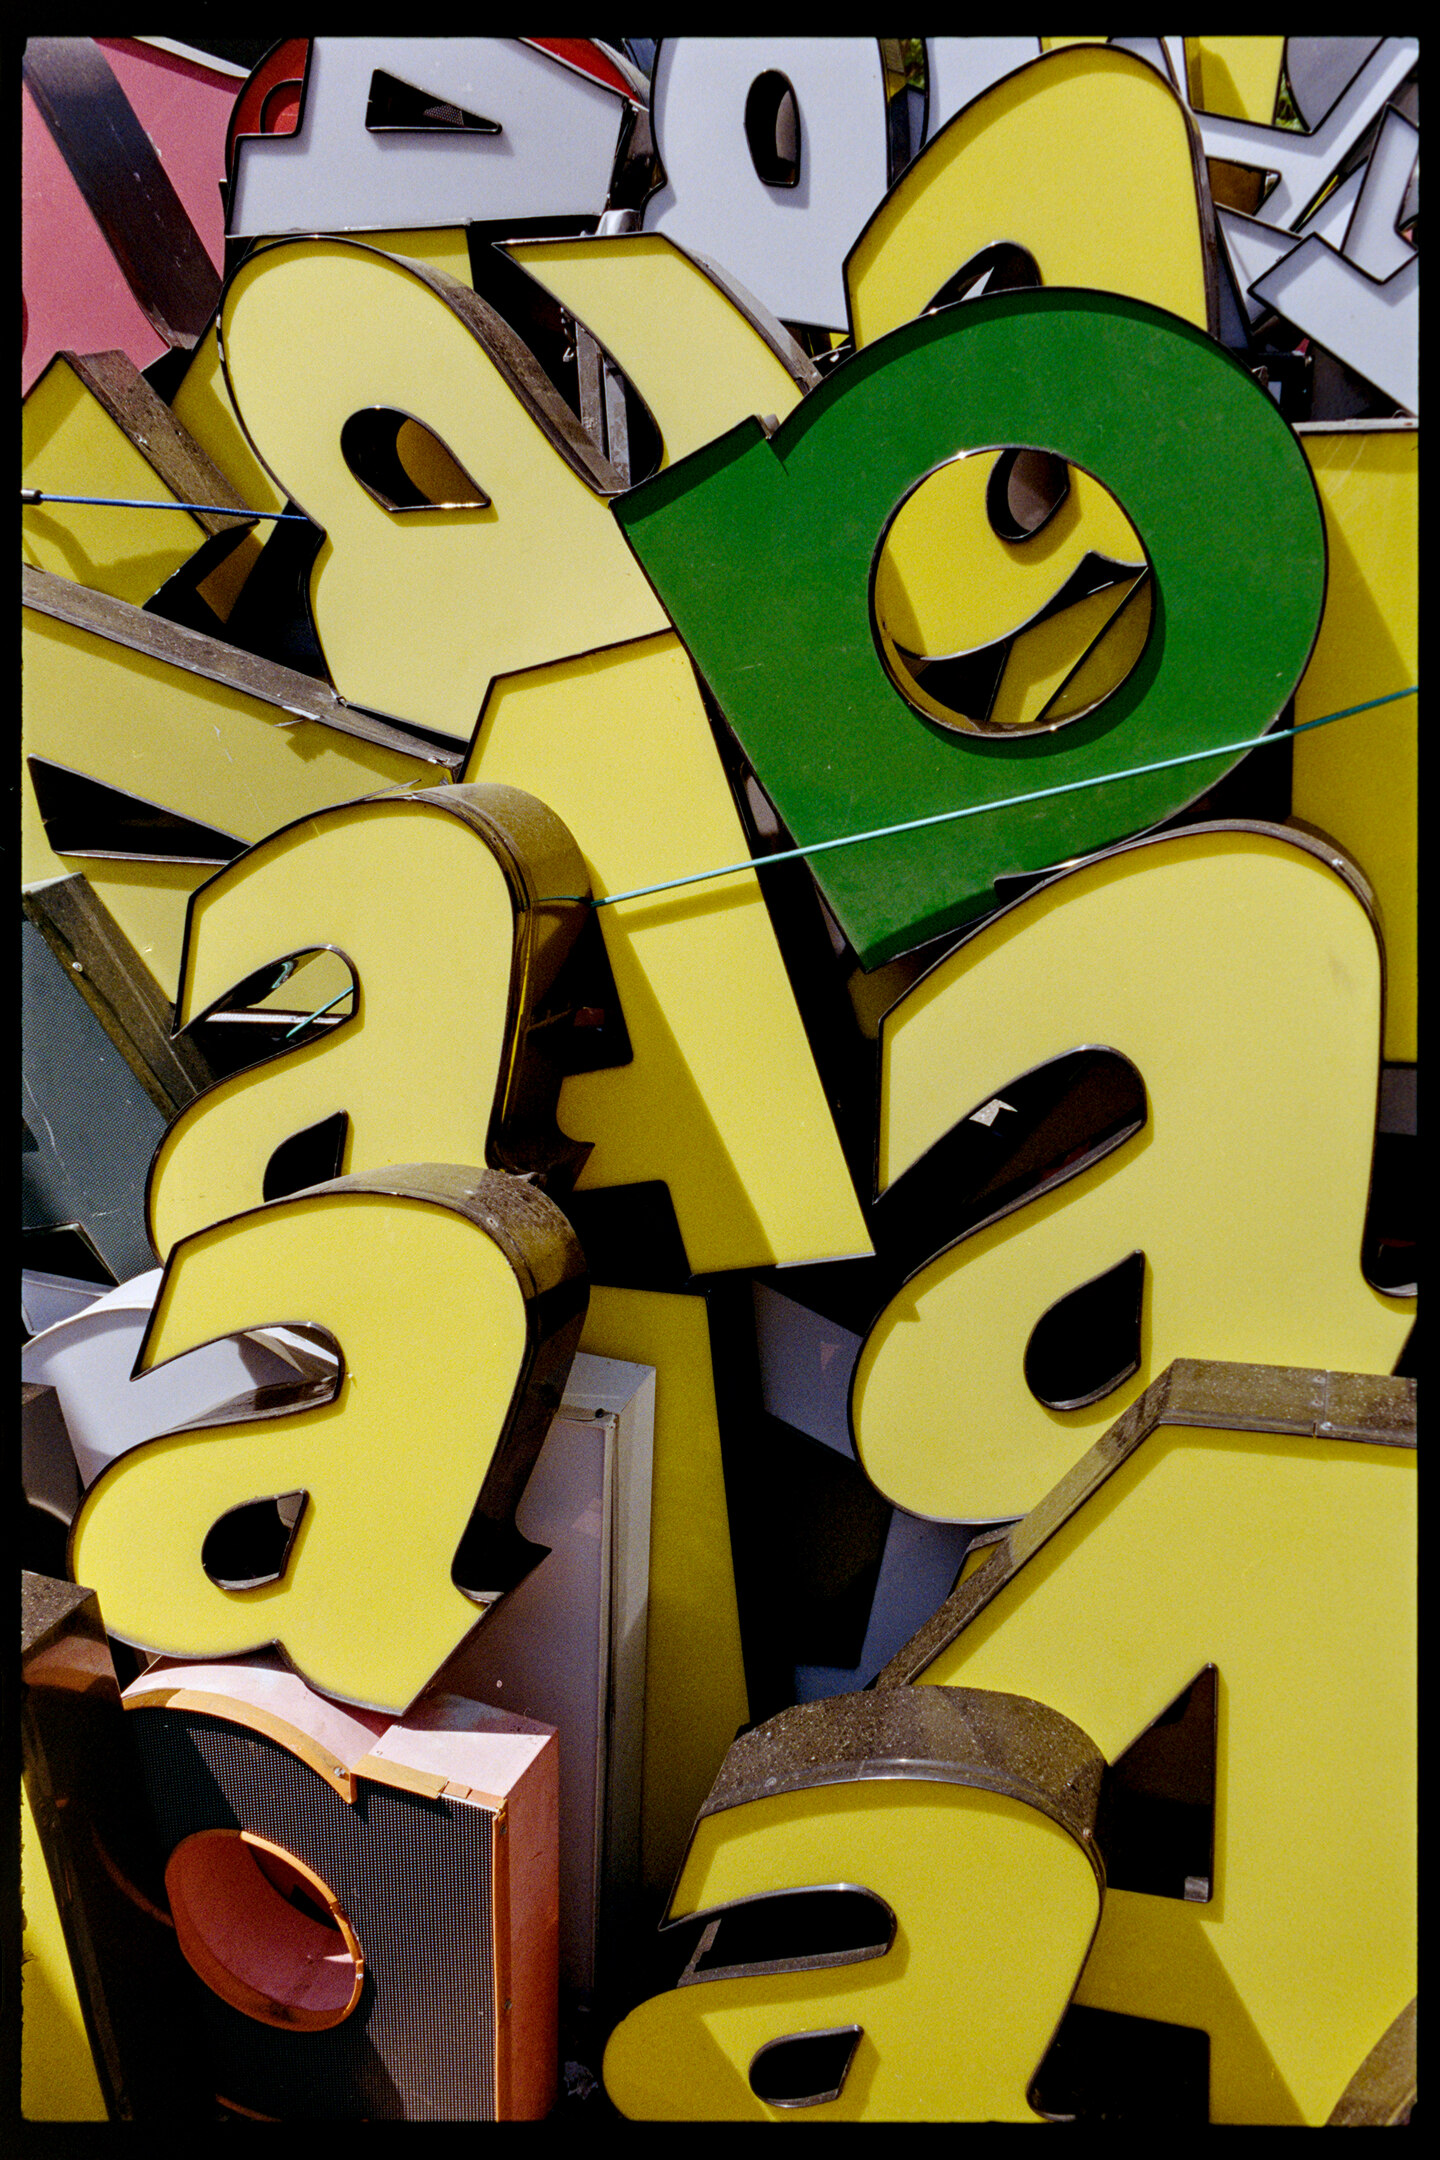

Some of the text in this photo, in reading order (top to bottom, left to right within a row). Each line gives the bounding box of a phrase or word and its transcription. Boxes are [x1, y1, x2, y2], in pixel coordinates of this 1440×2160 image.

[145, 784, 592, 1272] a
[847, 820, 1420, 1526] a
[70, 1165, 592, 1716] a
[602, 1684, 1107, 2124] a
